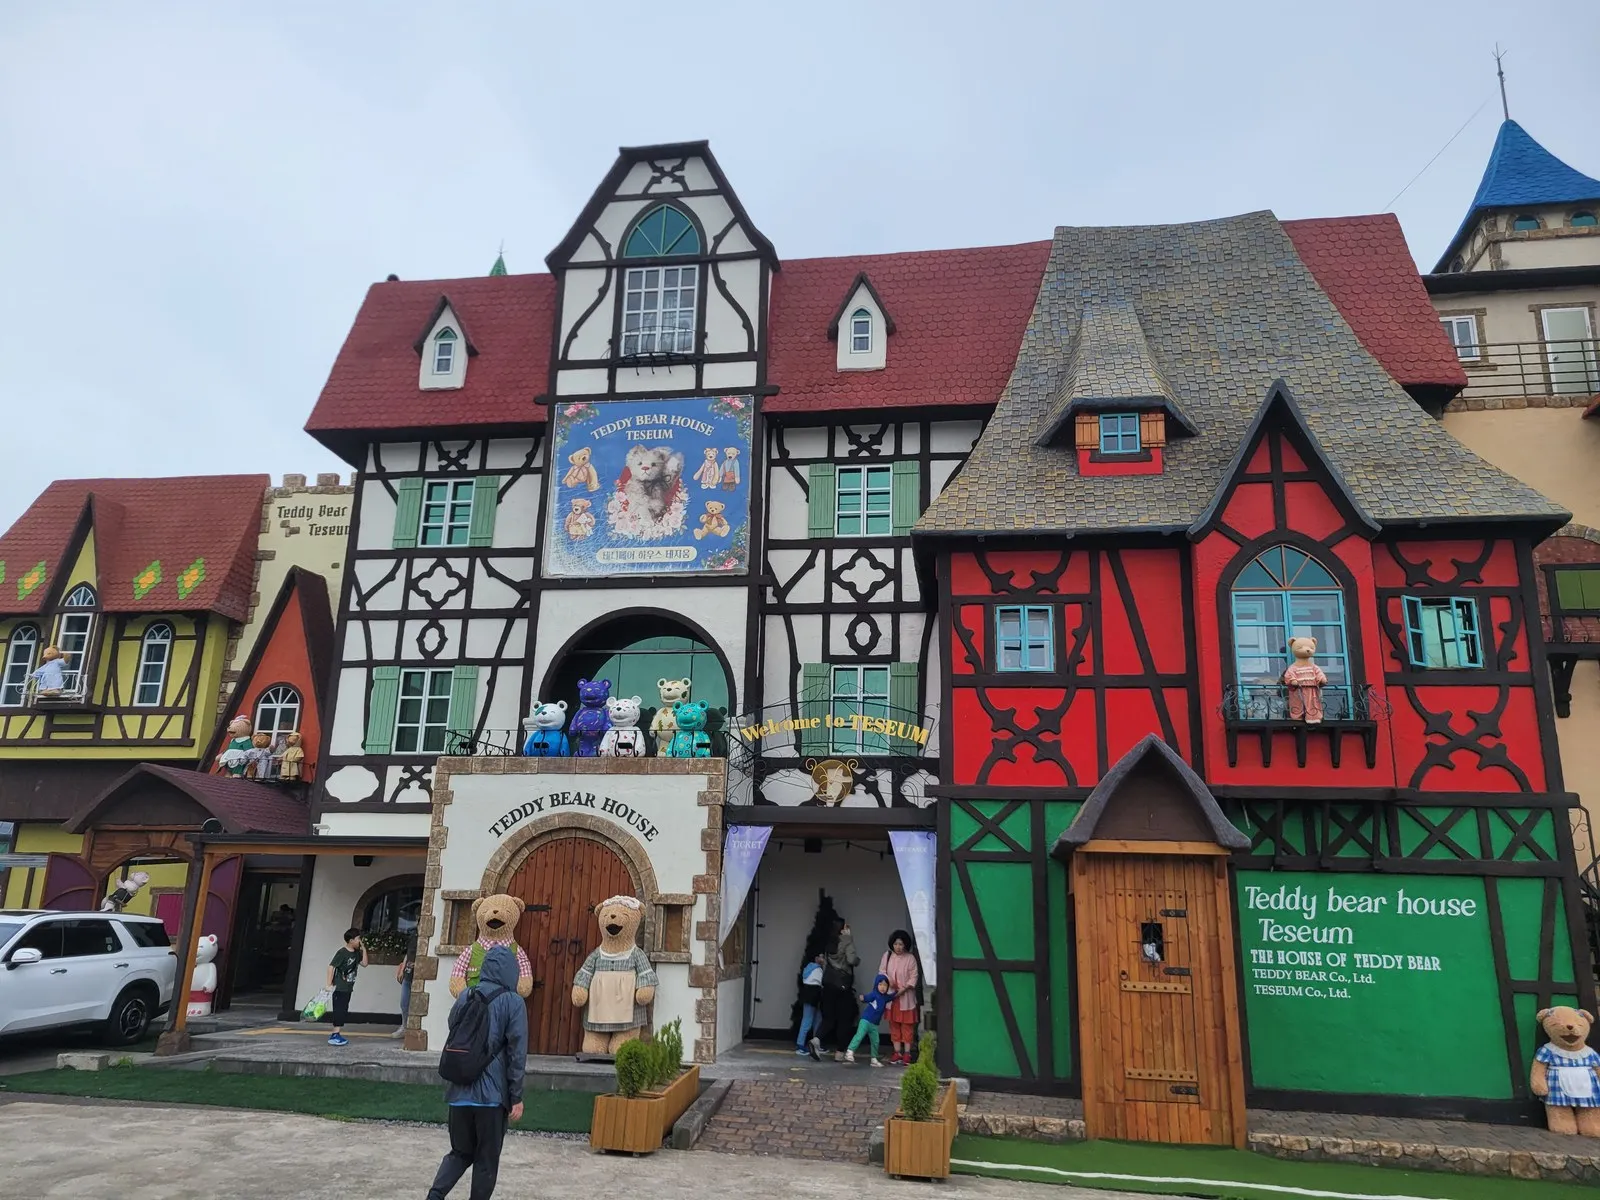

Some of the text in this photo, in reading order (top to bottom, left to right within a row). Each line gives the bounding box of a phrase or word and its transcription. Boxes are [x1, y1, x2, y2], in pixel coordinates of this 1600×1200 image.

[590, 413, 715, 440] TEDDY BEAR HOUSE
[626, 429, 673, 440] TESEUM
[277, 505, 348, 520] Teddy Bear
[639, 550, 662, 559] 하우스
[666, 549, 690, 559] 테지움
[825, 714, 845, 728] to
[848, 714, 929, 745] TESEUM
[488, 791, 659, 842] TEDDY BEAR HOUSE
[732, 840, 763, 849] TICKET
[1245, 885, 1477, 920] Teddy bear house
[1258, 918, 1353, 945] Teseum
[1250, 949, 1441, 971] THE HOUSE OF TEDDY BEAR
[1252, 968, 1376, 985] TEDDY BEAR Co., Ltd.
[1254, 984, 1351, 999] TESEUM Co., Ltd.
